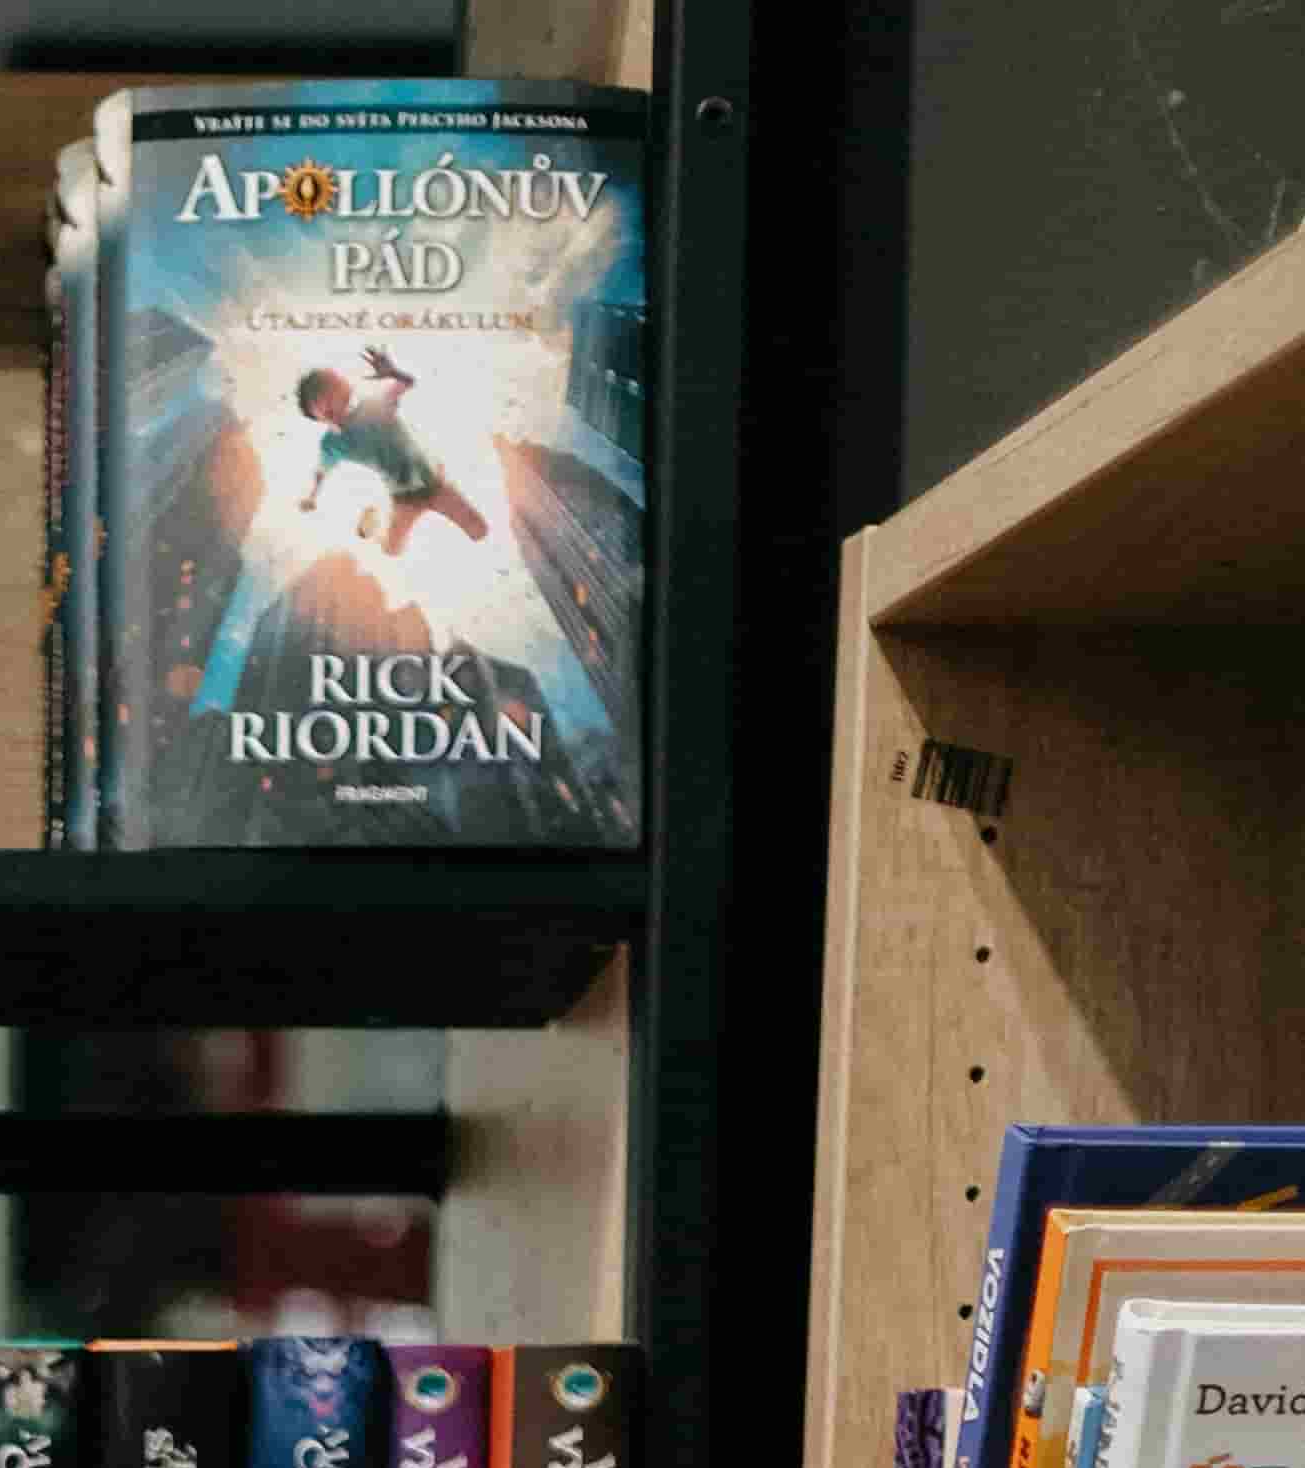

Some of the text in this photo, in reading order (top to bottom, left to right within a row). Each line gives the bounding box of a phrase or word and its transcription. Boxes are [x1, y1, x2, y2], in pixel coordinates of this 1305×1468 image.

[175, 152, 614, 223] APOLLÓNŮV
[331, 227, 465, 294] PÁD
[308, 652, 479, 706] RICK
[228, 710, 544, 763] RIORDAN
[962, 1246, 1005, 1424] VOZIDLA
